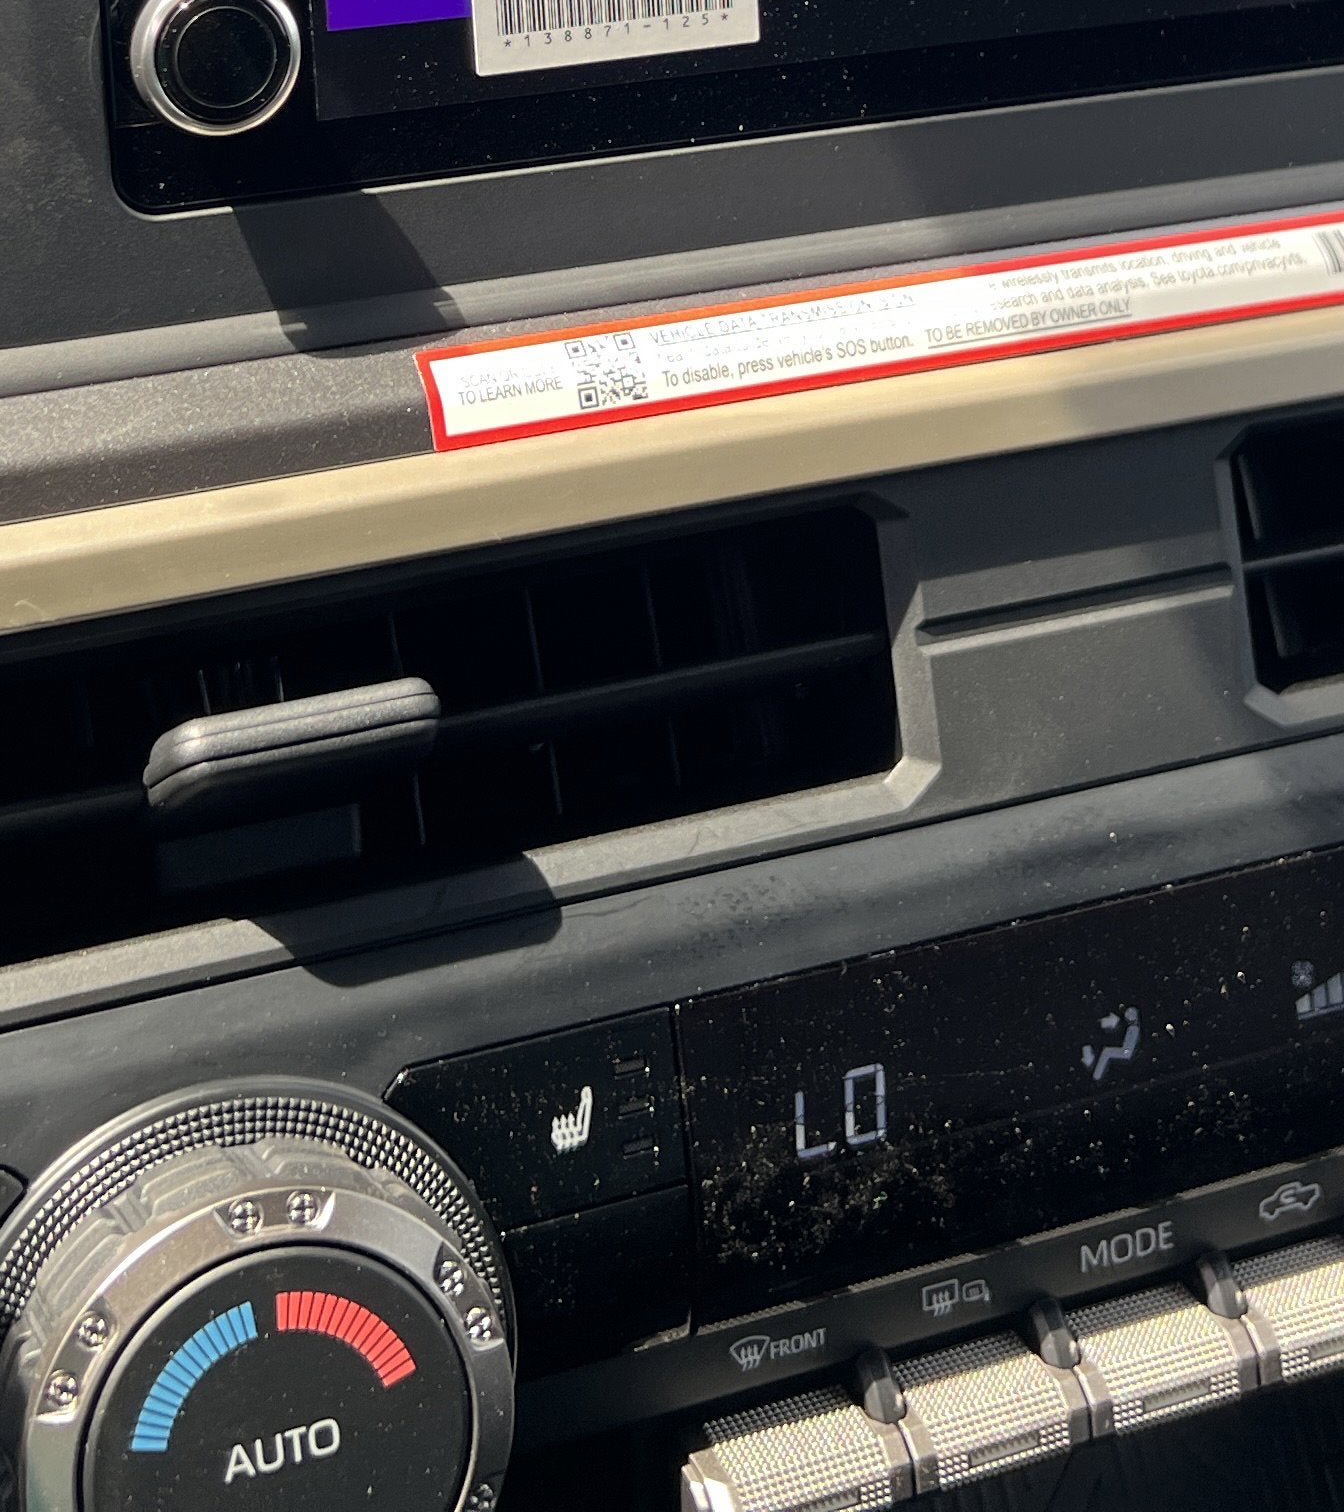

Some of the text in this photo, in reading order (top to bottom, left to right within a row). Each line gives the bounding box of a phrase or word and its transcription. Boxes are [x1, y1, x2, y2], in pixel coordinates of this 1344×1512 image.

[661, 369, 679, 388] To
[682, 359, 735, 385] disable,
[738, 355, 774, 380] press
[777, 345, 833, 369] vehicle's
[836, 338, 867, 358] SOS
[870, 332, 914, 354] button.
[924, 327, 942, 343] TO
[946, 324, 963, 340] BE
[965, 313, 1029, 337] REMOVED
[1030, 310, 1049, 327] BY
[1049, 302, 1097, 324] OWNER
[1099, 296, 1131, 315] ONLY
[458, 376, 564, 406] TO LEARN MORE
[1080, 1220, 1175, 1275] MODE
[769, 1327, 828, 1361] FRONT
[224, 1417, 341, 1484] AUTO
